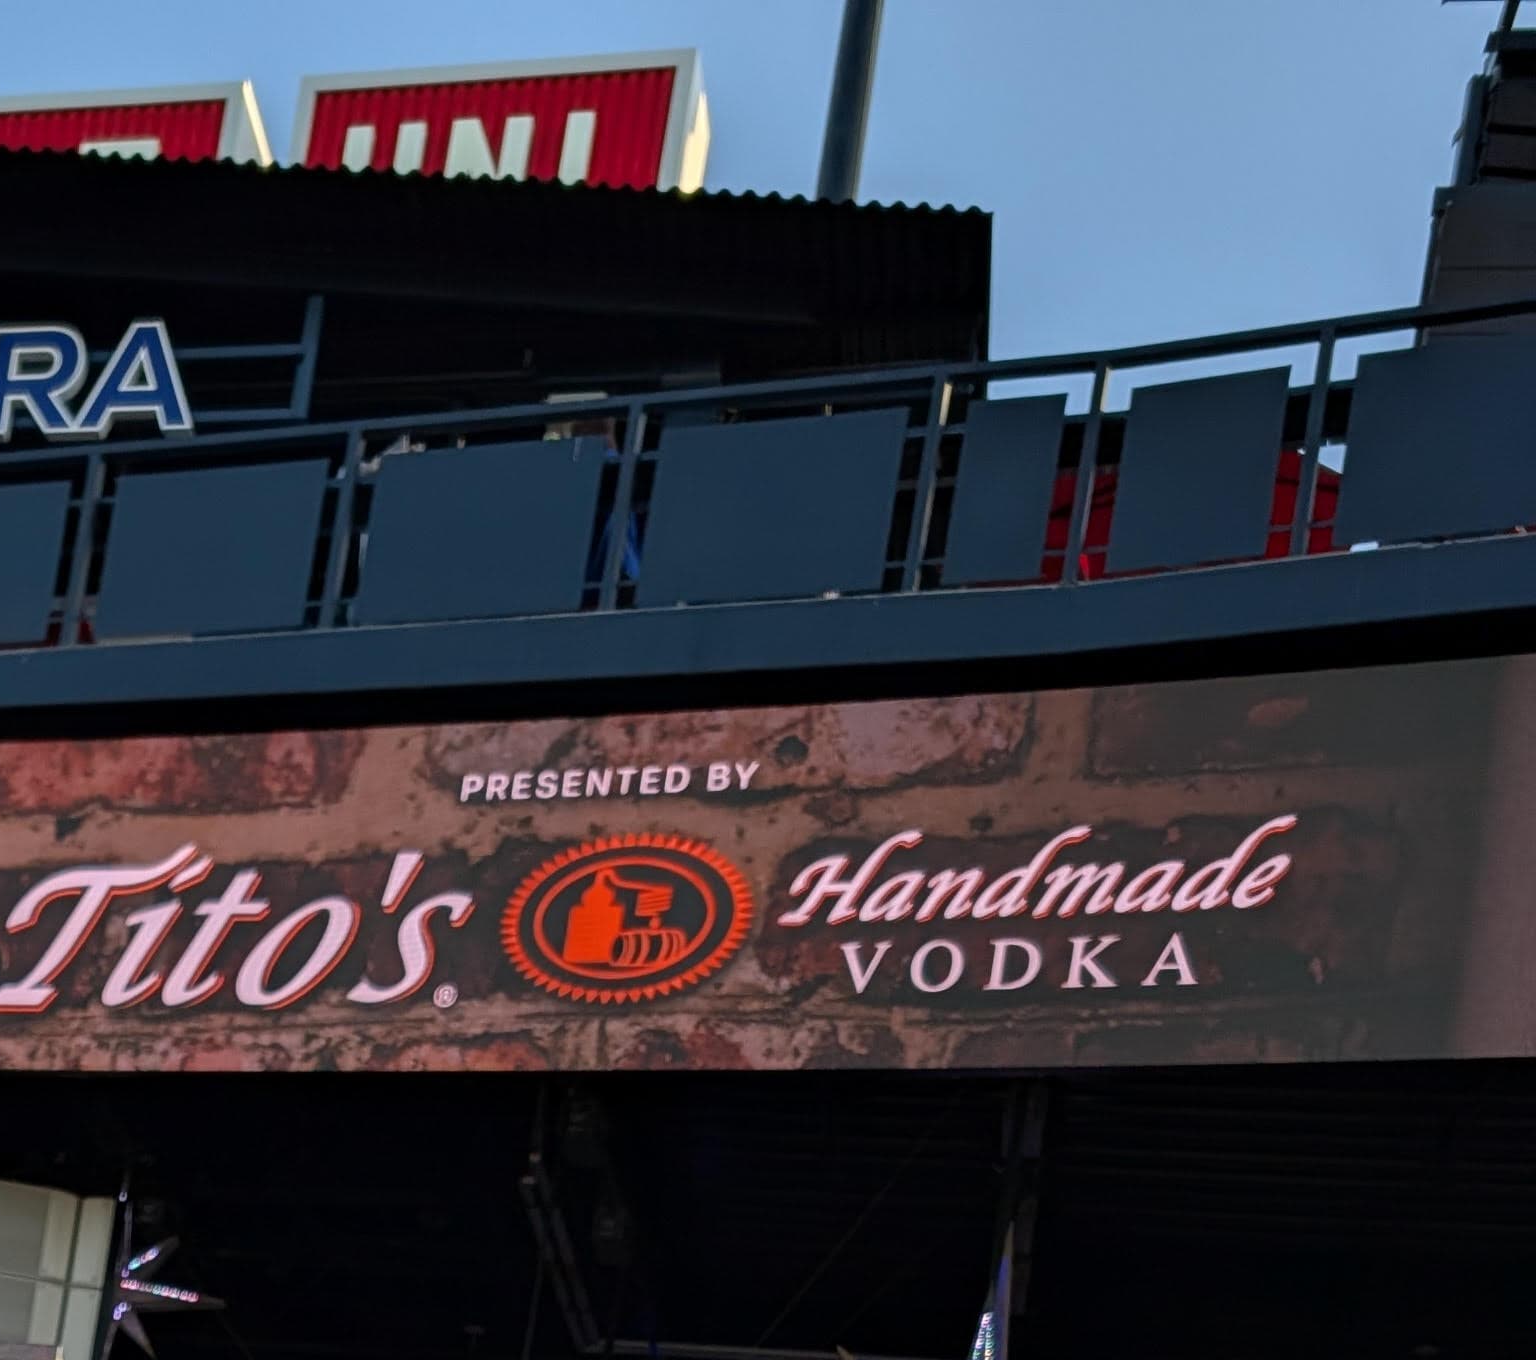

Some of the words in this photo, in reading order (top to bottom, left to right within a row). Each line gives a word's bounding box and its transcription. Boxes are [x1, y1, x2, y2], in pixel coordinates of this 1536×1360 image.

[459, 763, 692, 803] PRESENTED
[706, 760, 761, 793] BY
[776, 812, 1300, 929] Handmade
[840, 931, 1200, 995] VODKA
